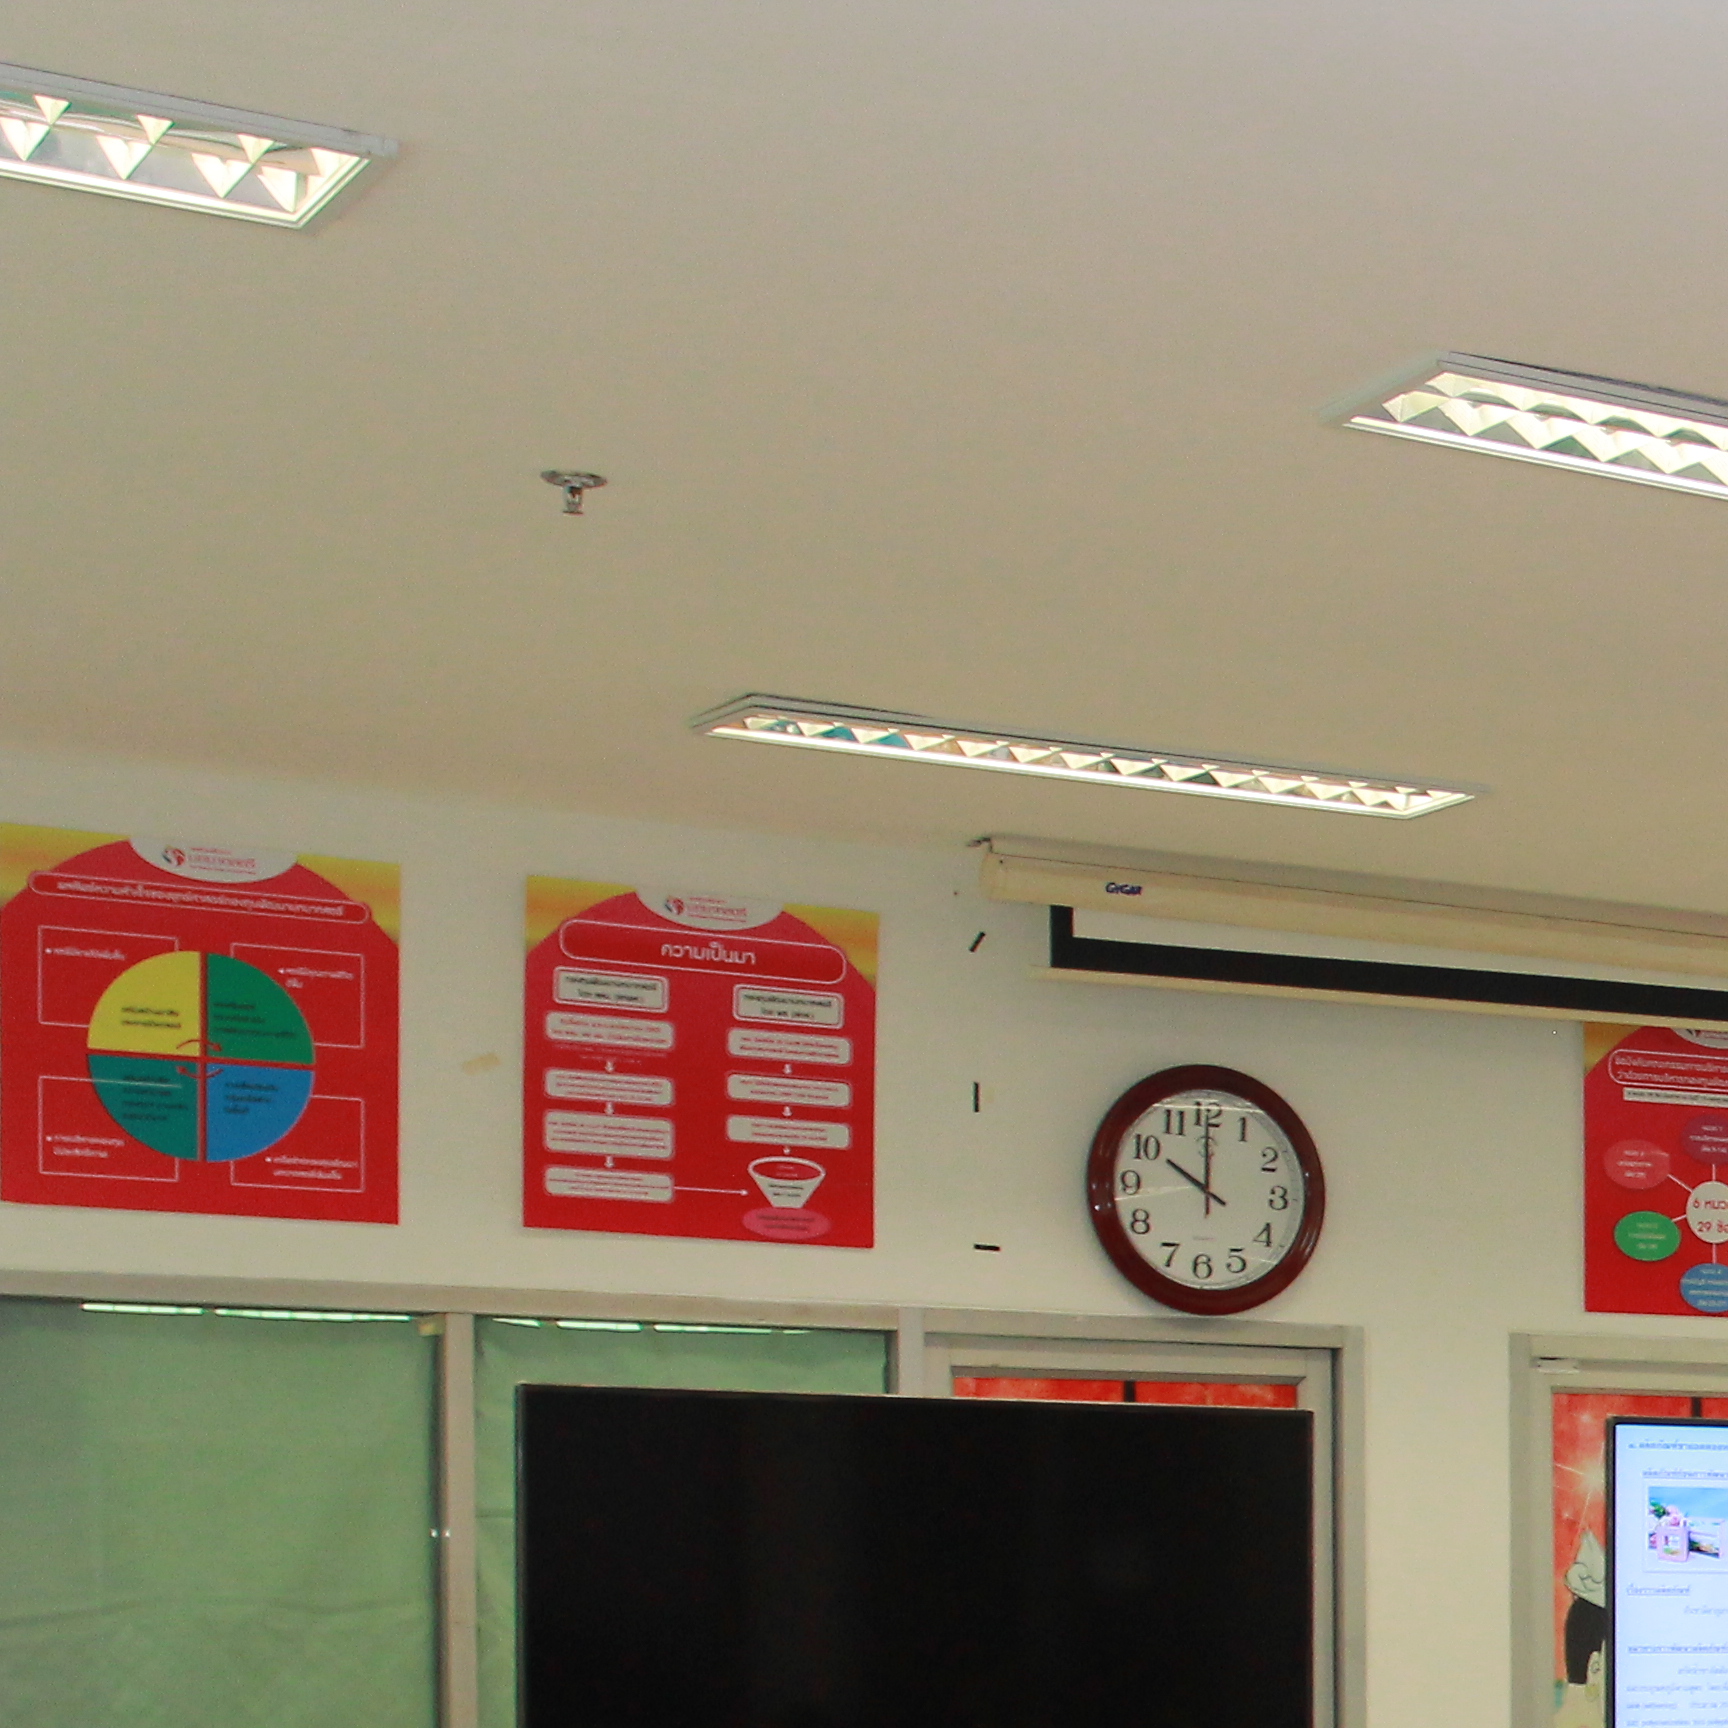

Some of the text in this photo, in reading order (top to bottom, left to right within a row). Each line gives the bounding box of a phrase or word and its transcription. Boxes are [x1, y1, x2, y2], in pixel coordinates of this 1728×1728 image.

[661, 941, 756, 965] ความเป็นมา
[1163, 1109, 1185, 1136] 11
[1195, 1101, 1222, 1128] 12
[1237, 1117, 1248, 1142] 1
[1133, 1133, 1160, 1161] 10
[1261, 1147, 1278, 1173] 2
[1120, 1169, 1141, 1195] 9
[1269, 1186, 1288, 1211] 3
[1130, 1208, 1150, 1235] 8
[1254, 1222, 1272, 1247] 4
[1697, 1221, 1712, 1233] 29
[1161, 1242, 1180, 1268] 7
[1192, 1253, 1213, 1280] 6
[1226, 1248, 1247, 1274] 5
